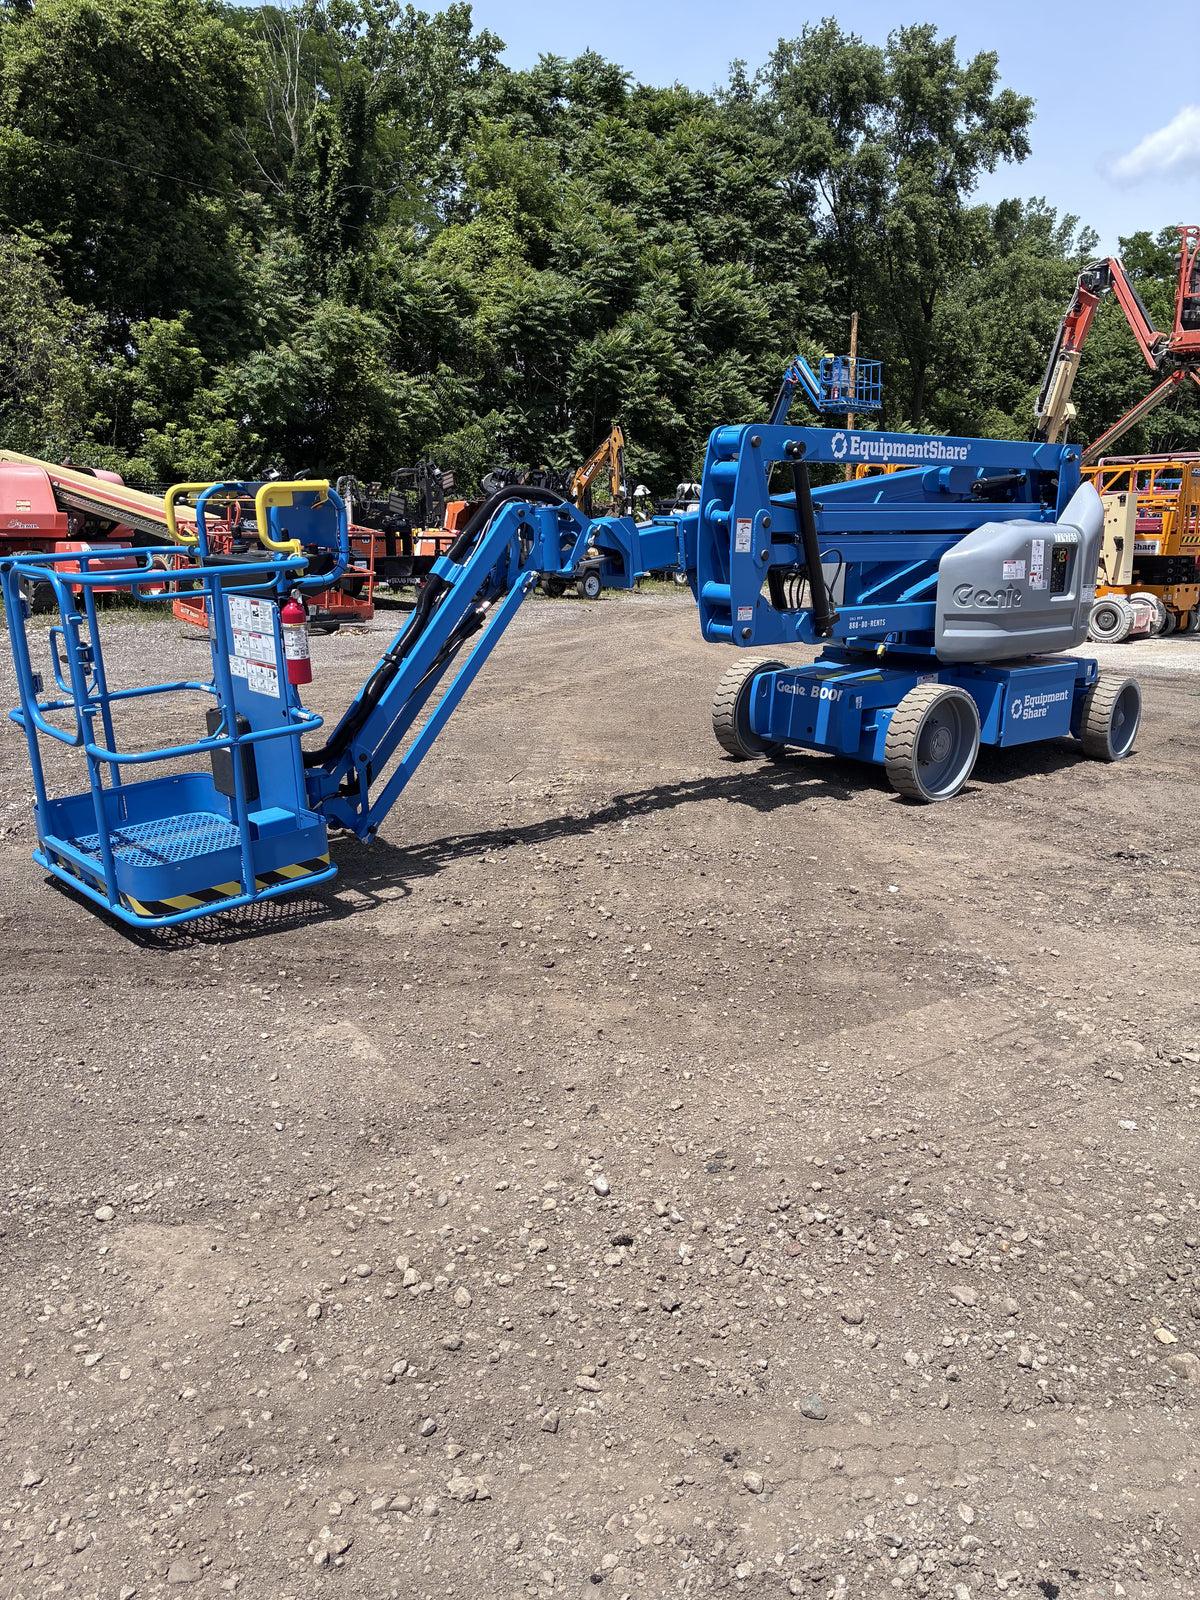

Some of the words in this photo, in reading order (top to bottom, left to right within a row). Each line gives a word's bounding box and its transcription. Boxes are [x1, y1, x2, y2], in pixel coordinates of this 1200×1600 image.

[850, 436, 968, 461] EquipmentShare
[953, 583, 1022, 608] Genie
[776, 680, 806, 696] Genie
[1024, 689, 1069, 708] Equipment
[1022, 707, 1047, 720] Share
